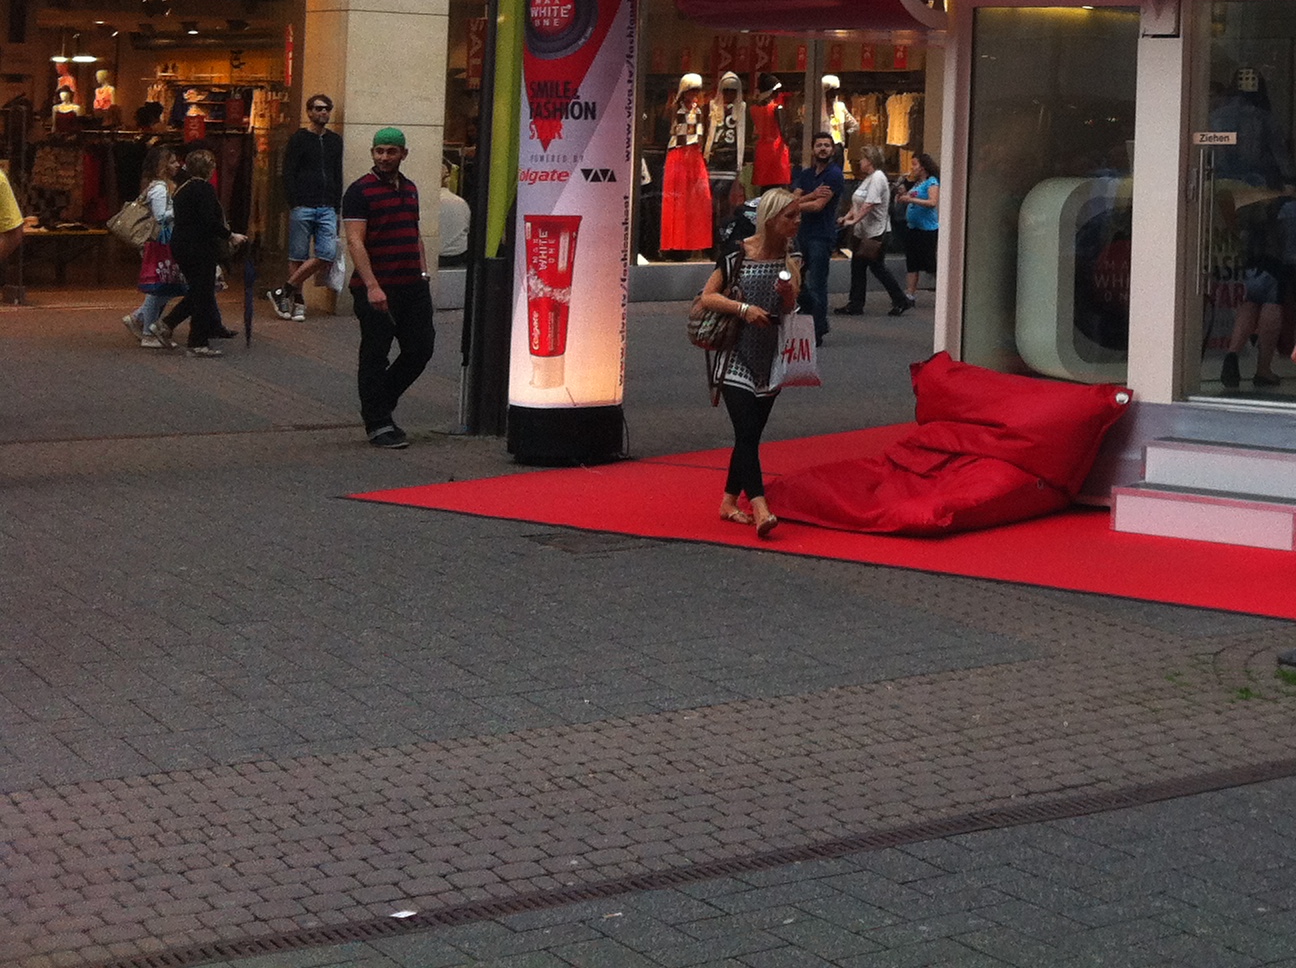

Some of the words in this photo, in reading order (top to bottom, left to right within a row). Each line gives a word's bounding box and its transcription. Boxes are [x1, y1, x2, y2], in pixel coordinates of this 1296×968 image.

[530, 5, 570, 19] WHITE
[529, 101, 597, 121] FASHION
[1199, 133, 1230, 143] Ziehen
[518, 168, 570, 186] olgate
[537, 229, 549, 271] WHITE
